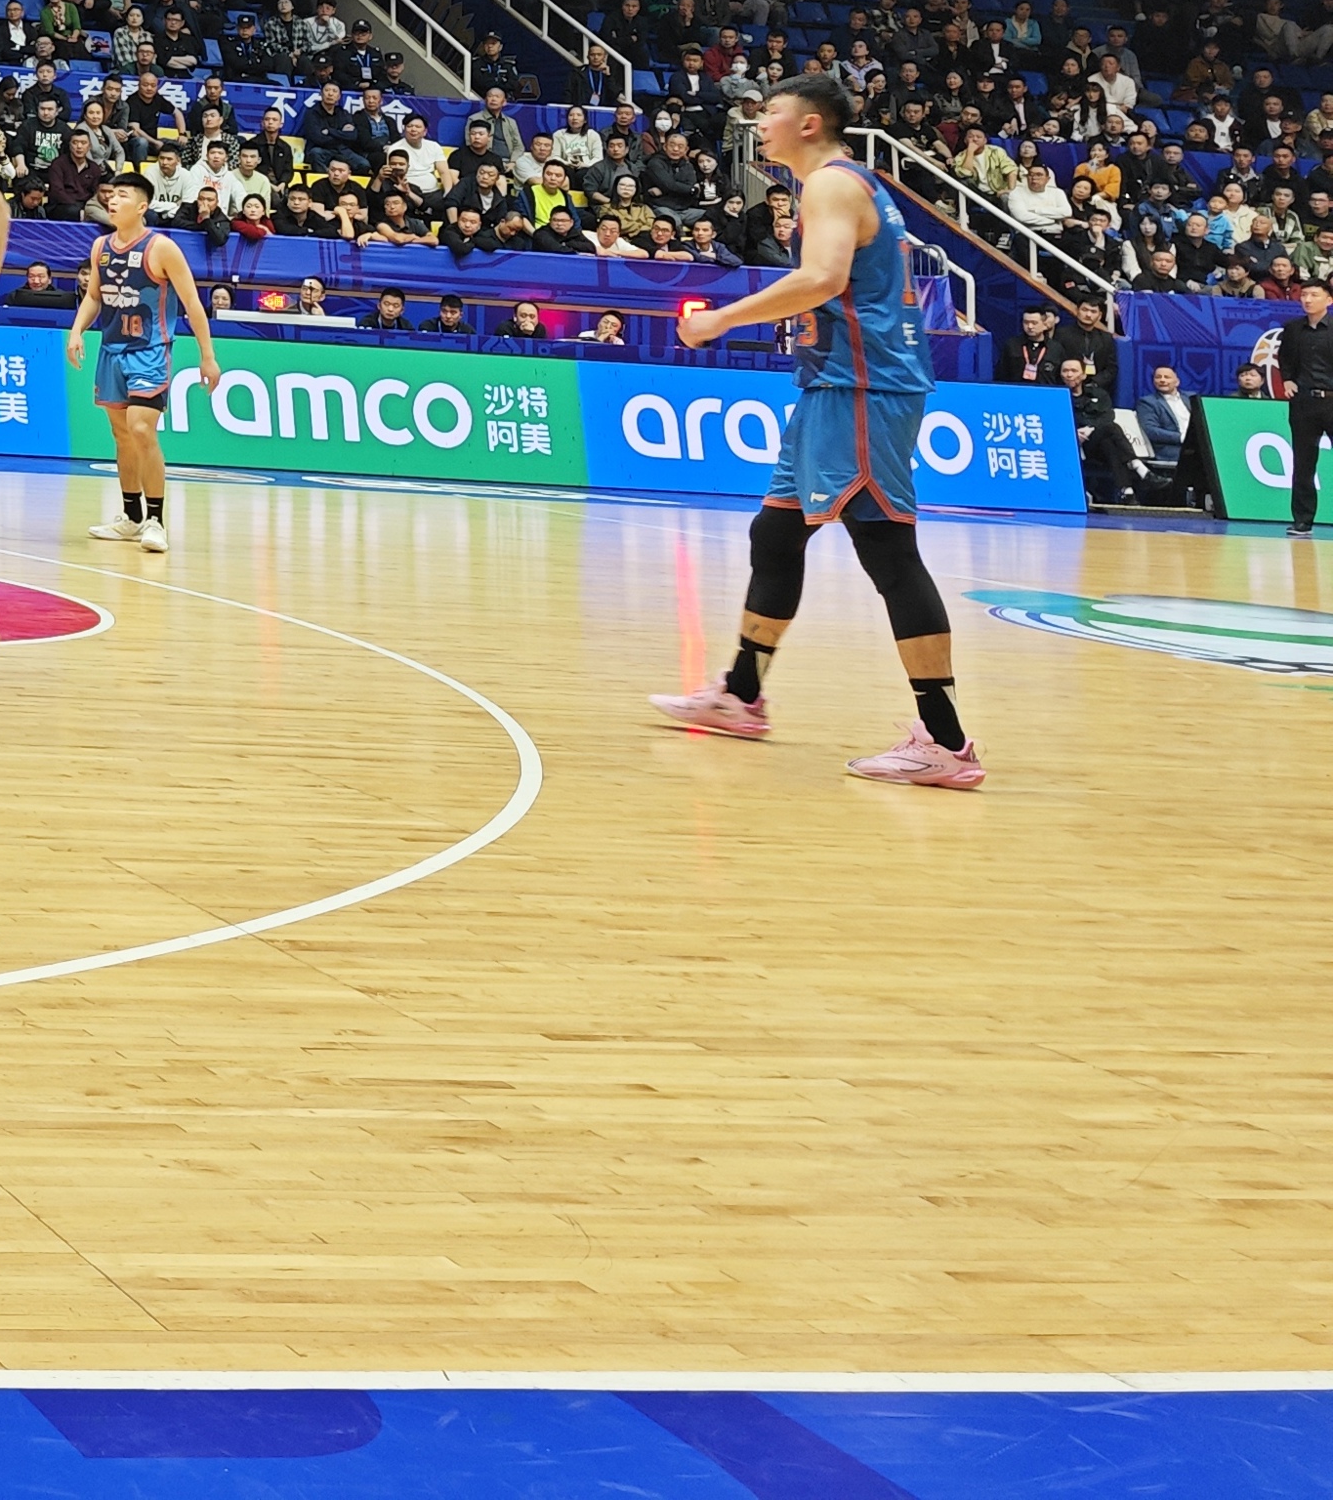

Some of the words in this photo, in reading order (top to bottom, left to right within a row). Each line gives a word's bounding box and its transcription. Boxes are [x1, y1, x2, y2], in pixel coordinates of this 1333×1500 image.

[120, 313, 144, 337] 18
[159, 367, 473, 449] ramco
[483, 384, 549, 419] 沙特
[486, 420, 553, 456] 阿美
[982, 412, 1044, 444] 沙特
[986, 446, 1050, 482] 阿美
